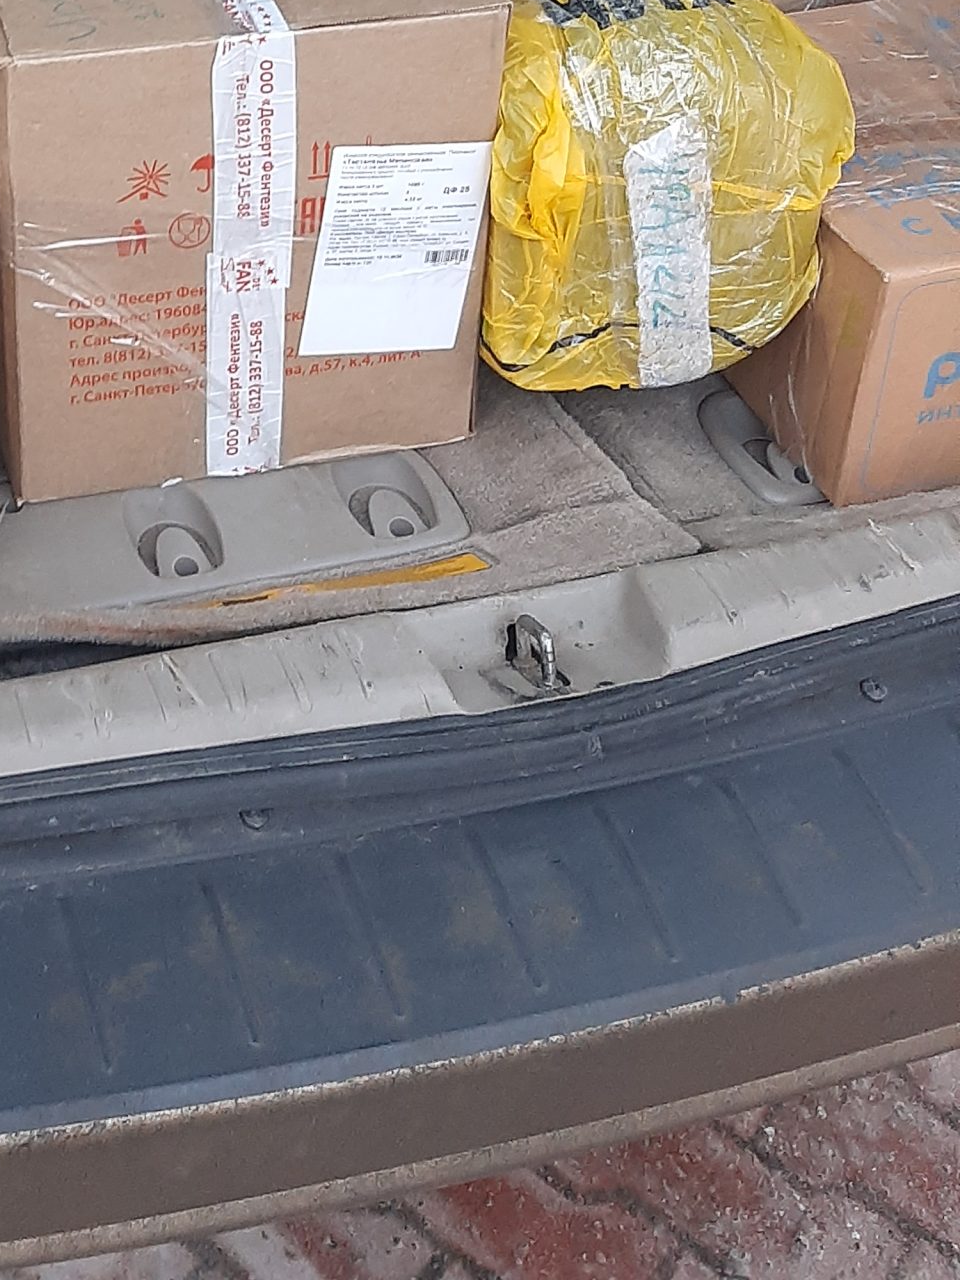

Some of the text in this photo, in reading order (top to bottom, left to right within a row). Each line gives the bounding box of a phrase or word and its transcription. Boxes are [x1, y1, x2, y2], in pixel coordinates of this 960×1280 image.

[257, 59, 275, 228] ООО «Десерт Фентези»
[69, 357, 99, 368] тел.
[103, 348, 151, 364] 8(812)
[227, 312, 240, 373] Фентези»
[248, 319, 263, 381] 337-15-88
[70, 371, 118, 388] Адрес
[226, 428, 239, 456] ООО
